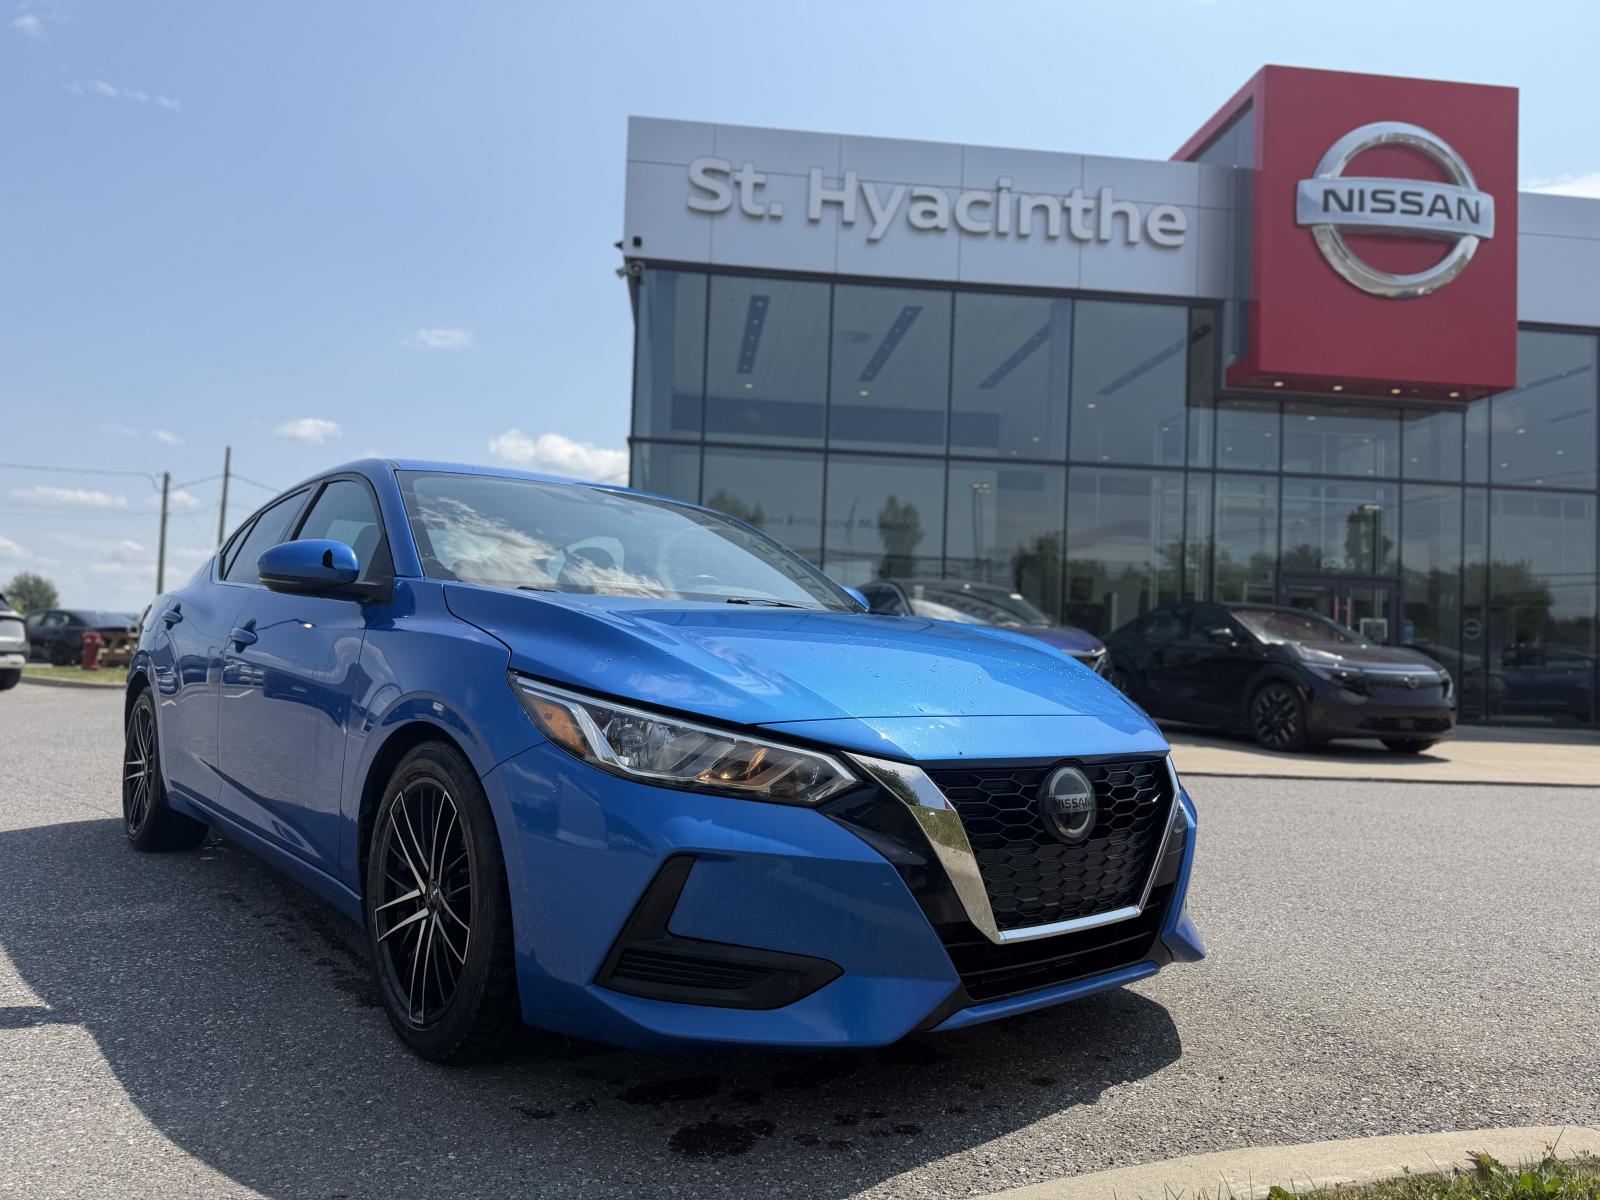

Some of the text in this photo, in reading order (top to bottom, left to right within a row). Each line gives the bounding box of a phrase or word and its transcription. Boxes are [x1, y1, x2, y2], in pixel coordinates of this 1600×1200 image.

[687, 157, 1187, 247] St. Hyacinthe
[1322, 188, 1480, 225] NISSAN
